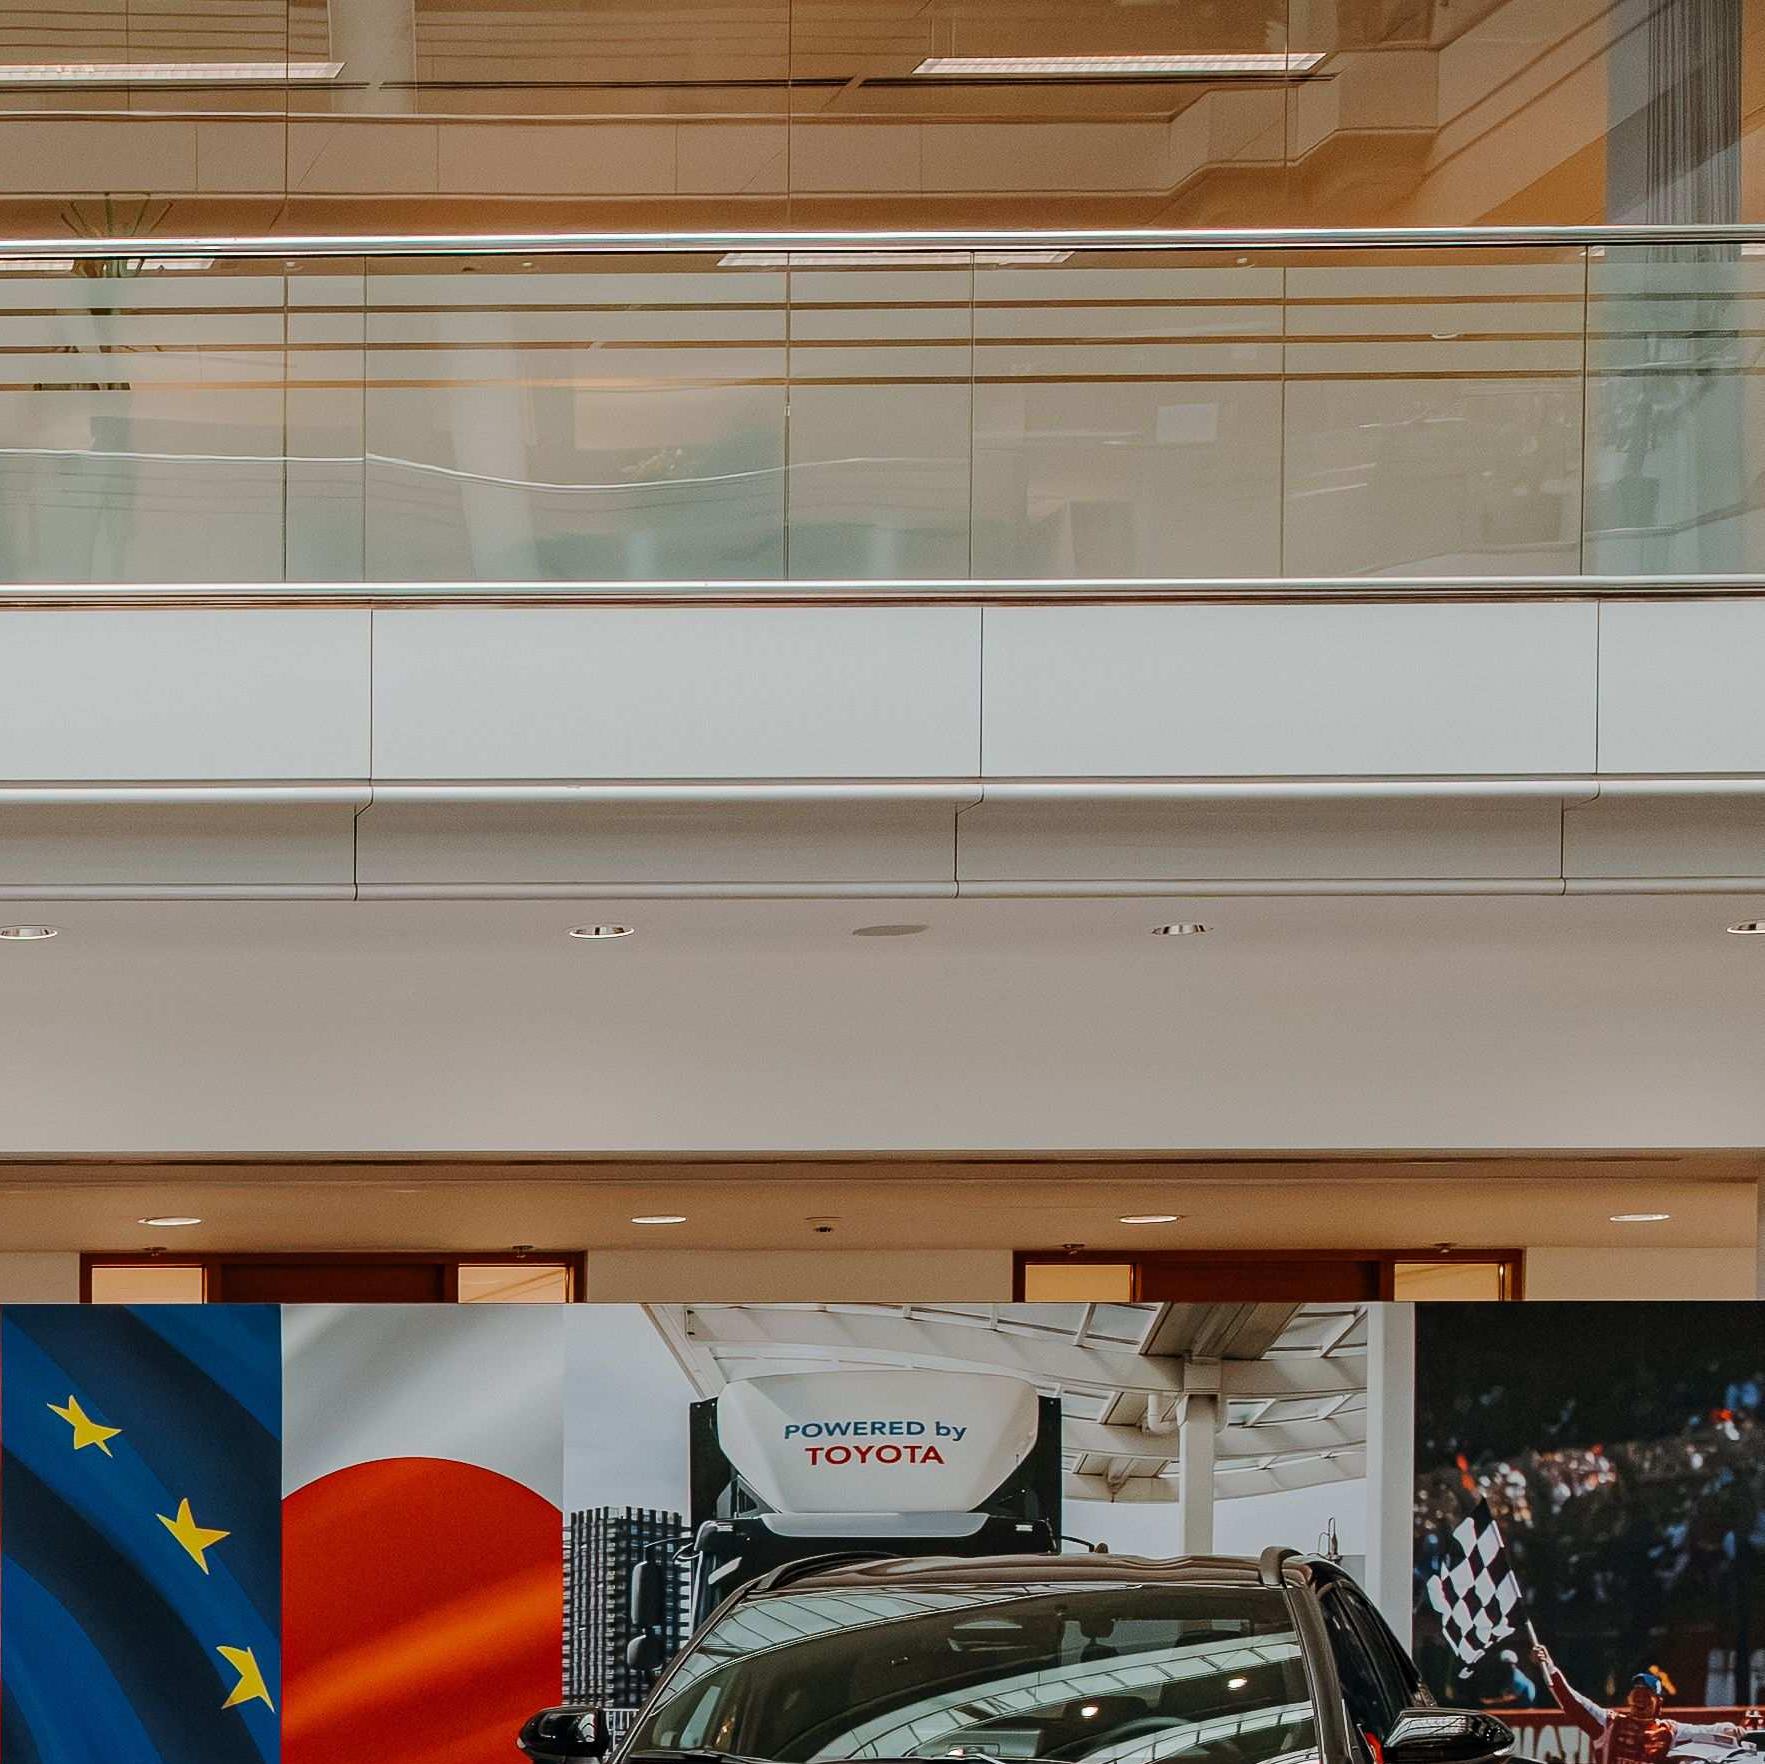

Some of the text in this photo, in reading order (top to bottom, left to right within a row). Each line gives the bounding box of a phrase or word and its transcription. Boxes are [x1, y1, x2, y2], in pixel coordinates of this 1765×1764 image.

[784, 1421, 967, 1441] POWERED by
[805, 1444, 945, 1466] TOYOTA
